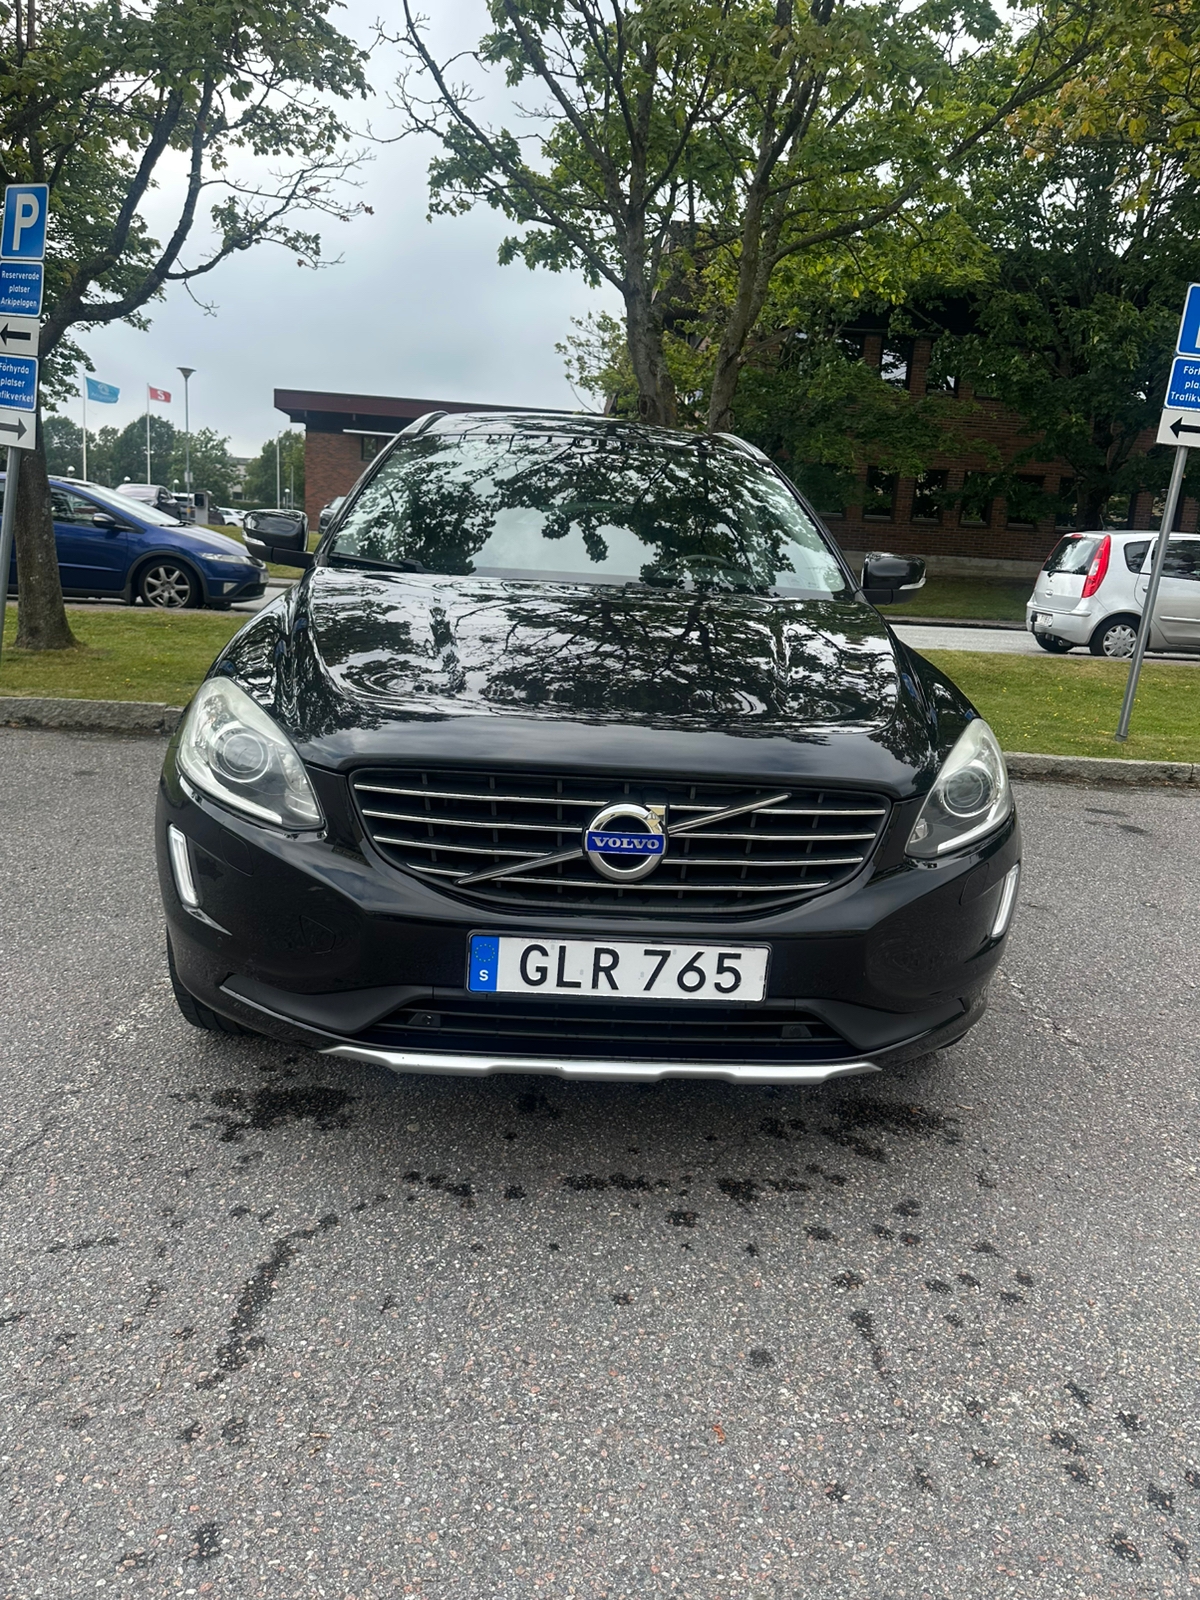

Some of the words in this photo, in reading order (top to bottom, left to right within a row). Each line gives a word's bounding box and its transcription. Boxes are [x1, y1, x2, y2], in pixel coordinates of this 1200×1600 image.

[12, 193, 40, 251] P
[2, 271, 39, 280] Reserverade
[9, 285, 30, 294] platser
[0, 297, 37, 308] Arkipelagen
[0, 377, 25, 387] platser
[1184, 380, 1200, 389] pla
[592, 836, 661, 851] VOLVO
[519, 943, 621, 991] GLR
[642, 949, 743, 994] 765
[478, 969, 490, 982] S
